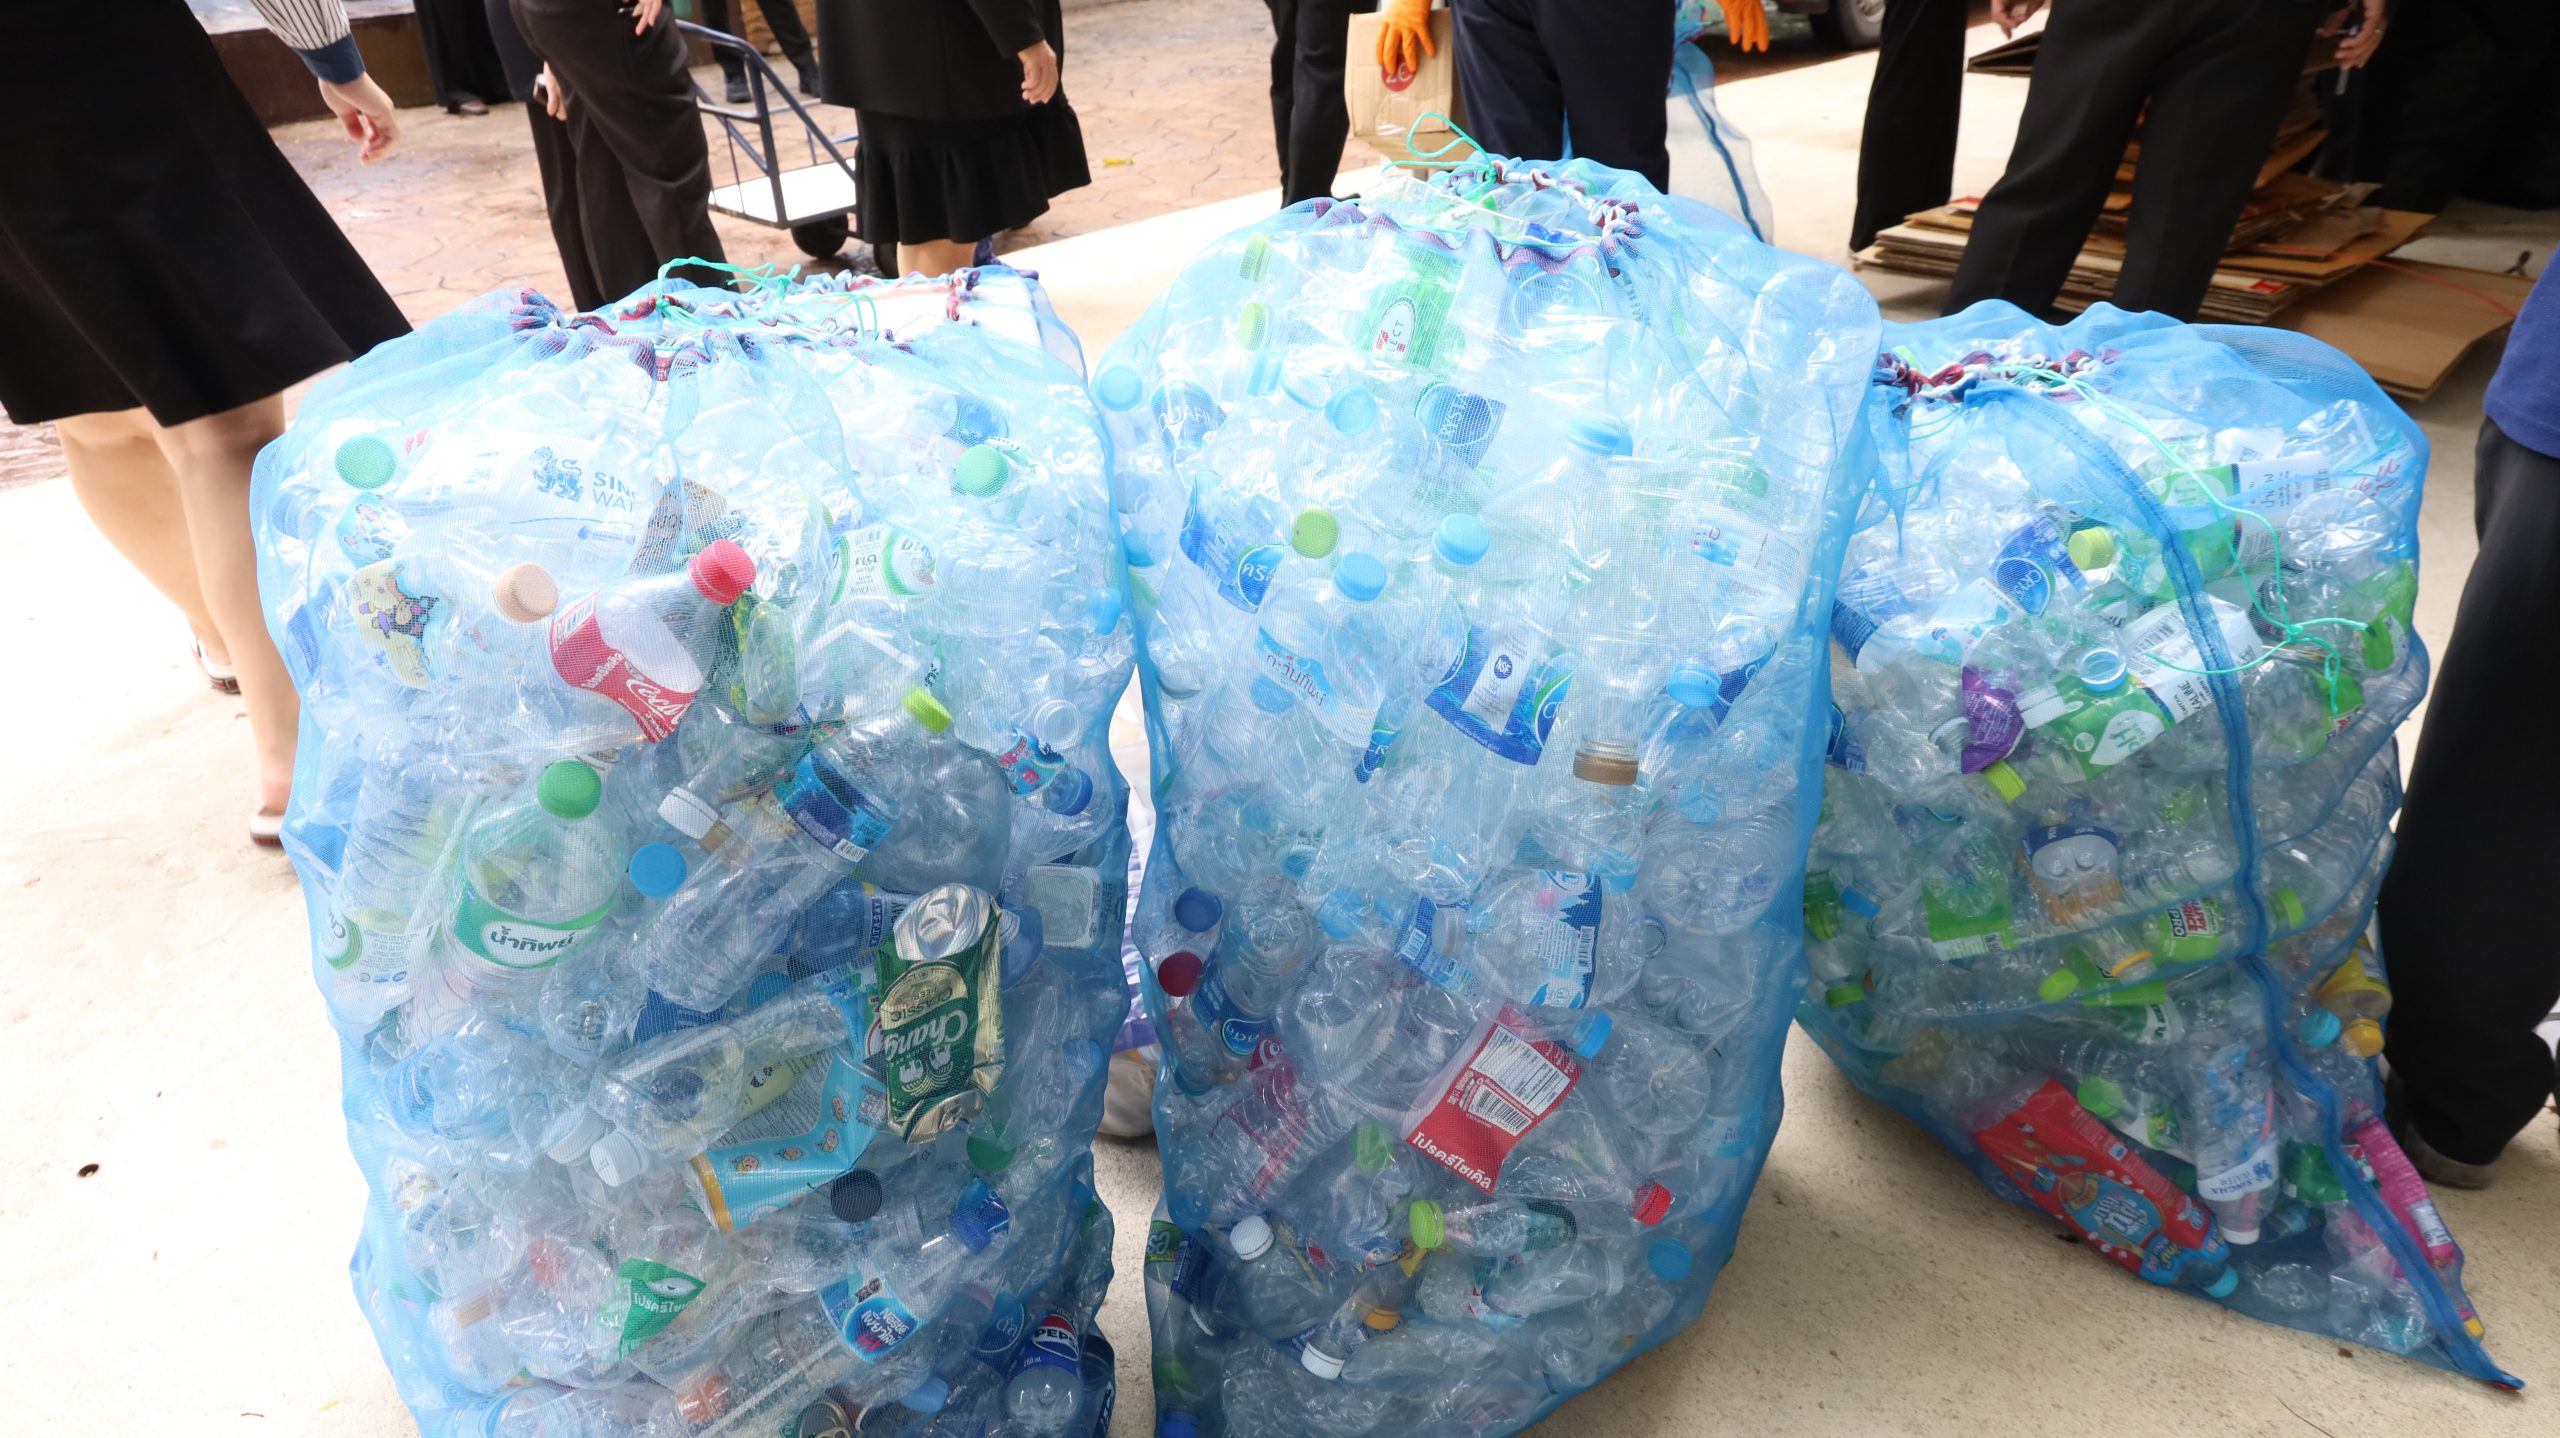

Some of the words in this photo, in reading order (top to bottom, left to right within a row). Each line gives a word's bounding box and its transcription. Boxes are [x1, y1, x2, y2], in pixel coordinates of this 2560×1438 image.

[1496, 658, 1511, 674] NSF
[2167, 908, 2186, 937] PRO
[890, 987, 953, 1022] CLASSIC
[884, 1009, 969, 1061] Chang
[1034, 1328, 1079, 1351] PEPS
